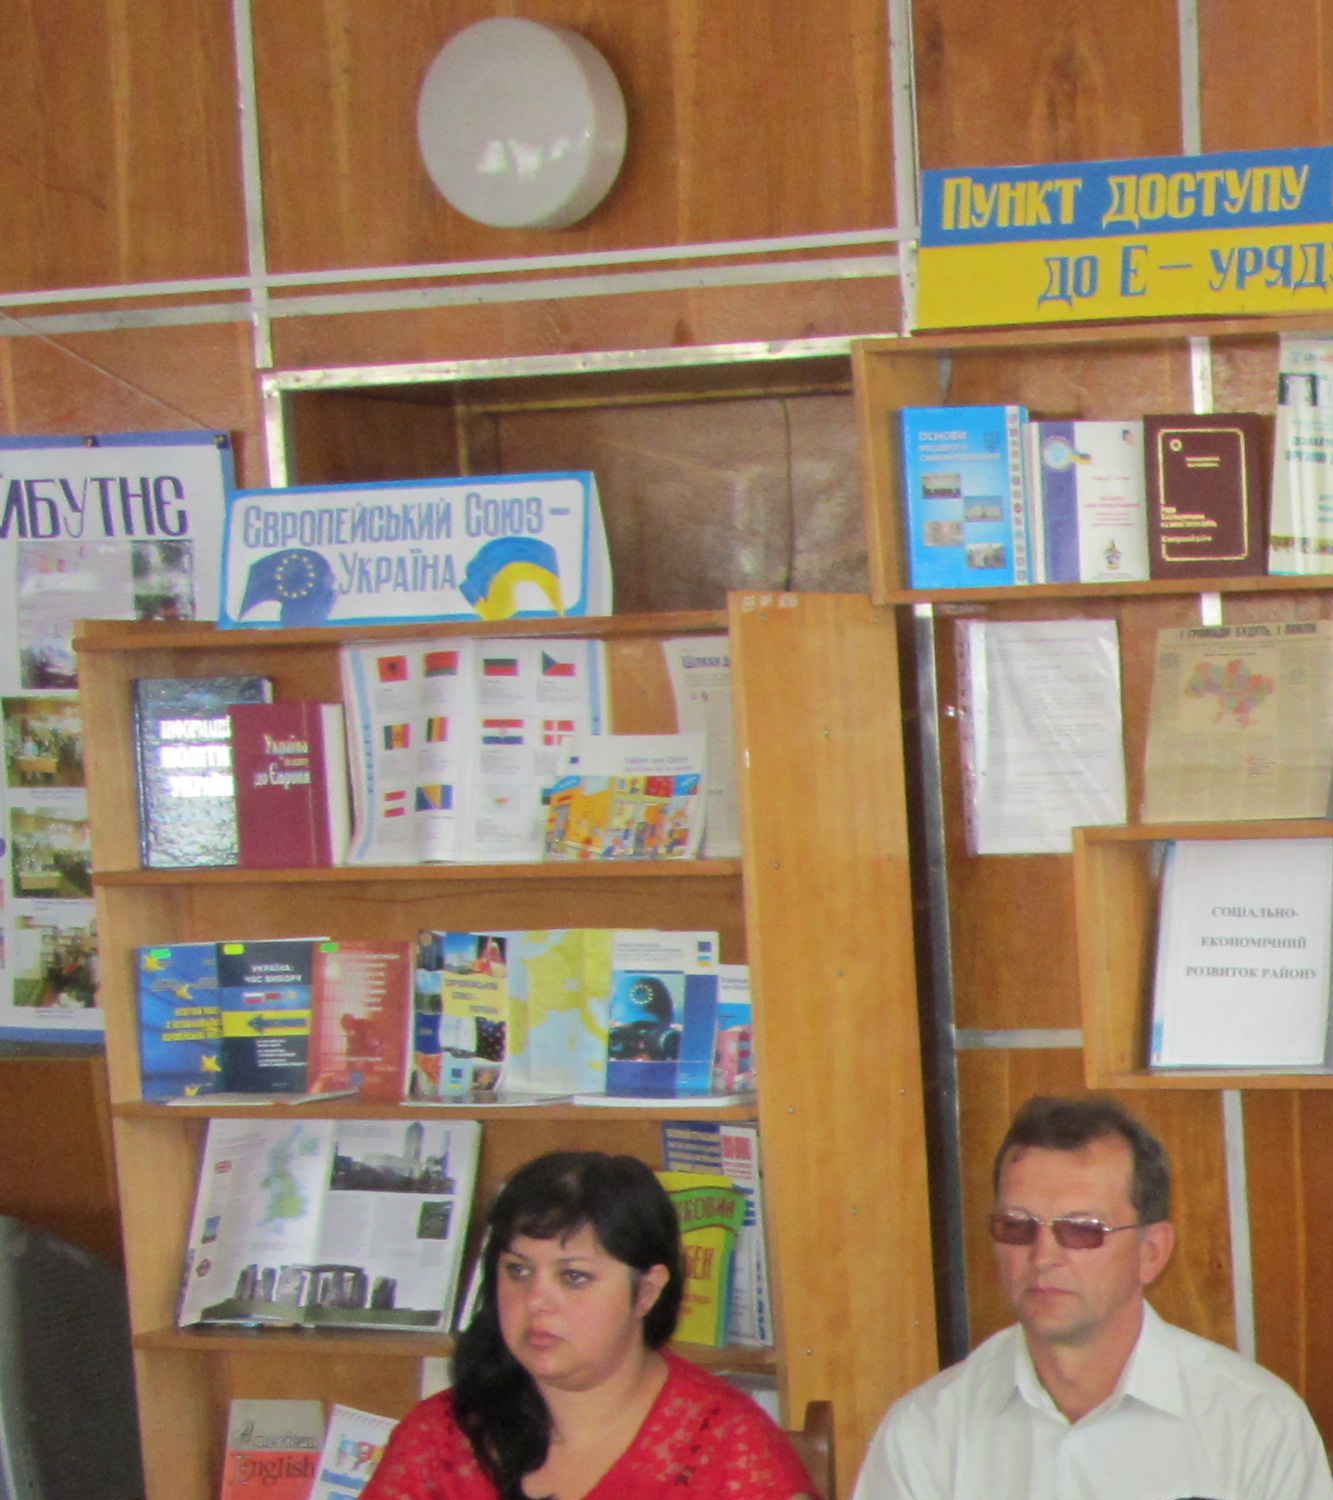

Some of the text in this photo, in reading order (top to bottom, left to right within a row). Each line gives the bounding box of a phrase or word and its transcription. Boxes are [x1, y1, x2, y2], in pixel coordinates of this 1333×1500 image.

[942, 177, 1081, 231] ПУНКТ
[1101, 165, 1308, 231] ДОСТУПУ
[1037, 256, 1099, 307] ДО
[1212, 906, 1298, 919] СОЦІАЛЬНО-
[1201, 935, 1307, 950] ЕКОНОМІЧНИЙ
[1186, 964, 1317, 980] РОЗВИТОК РАЙОНУ
[231, 1454, 315, 1486] English
